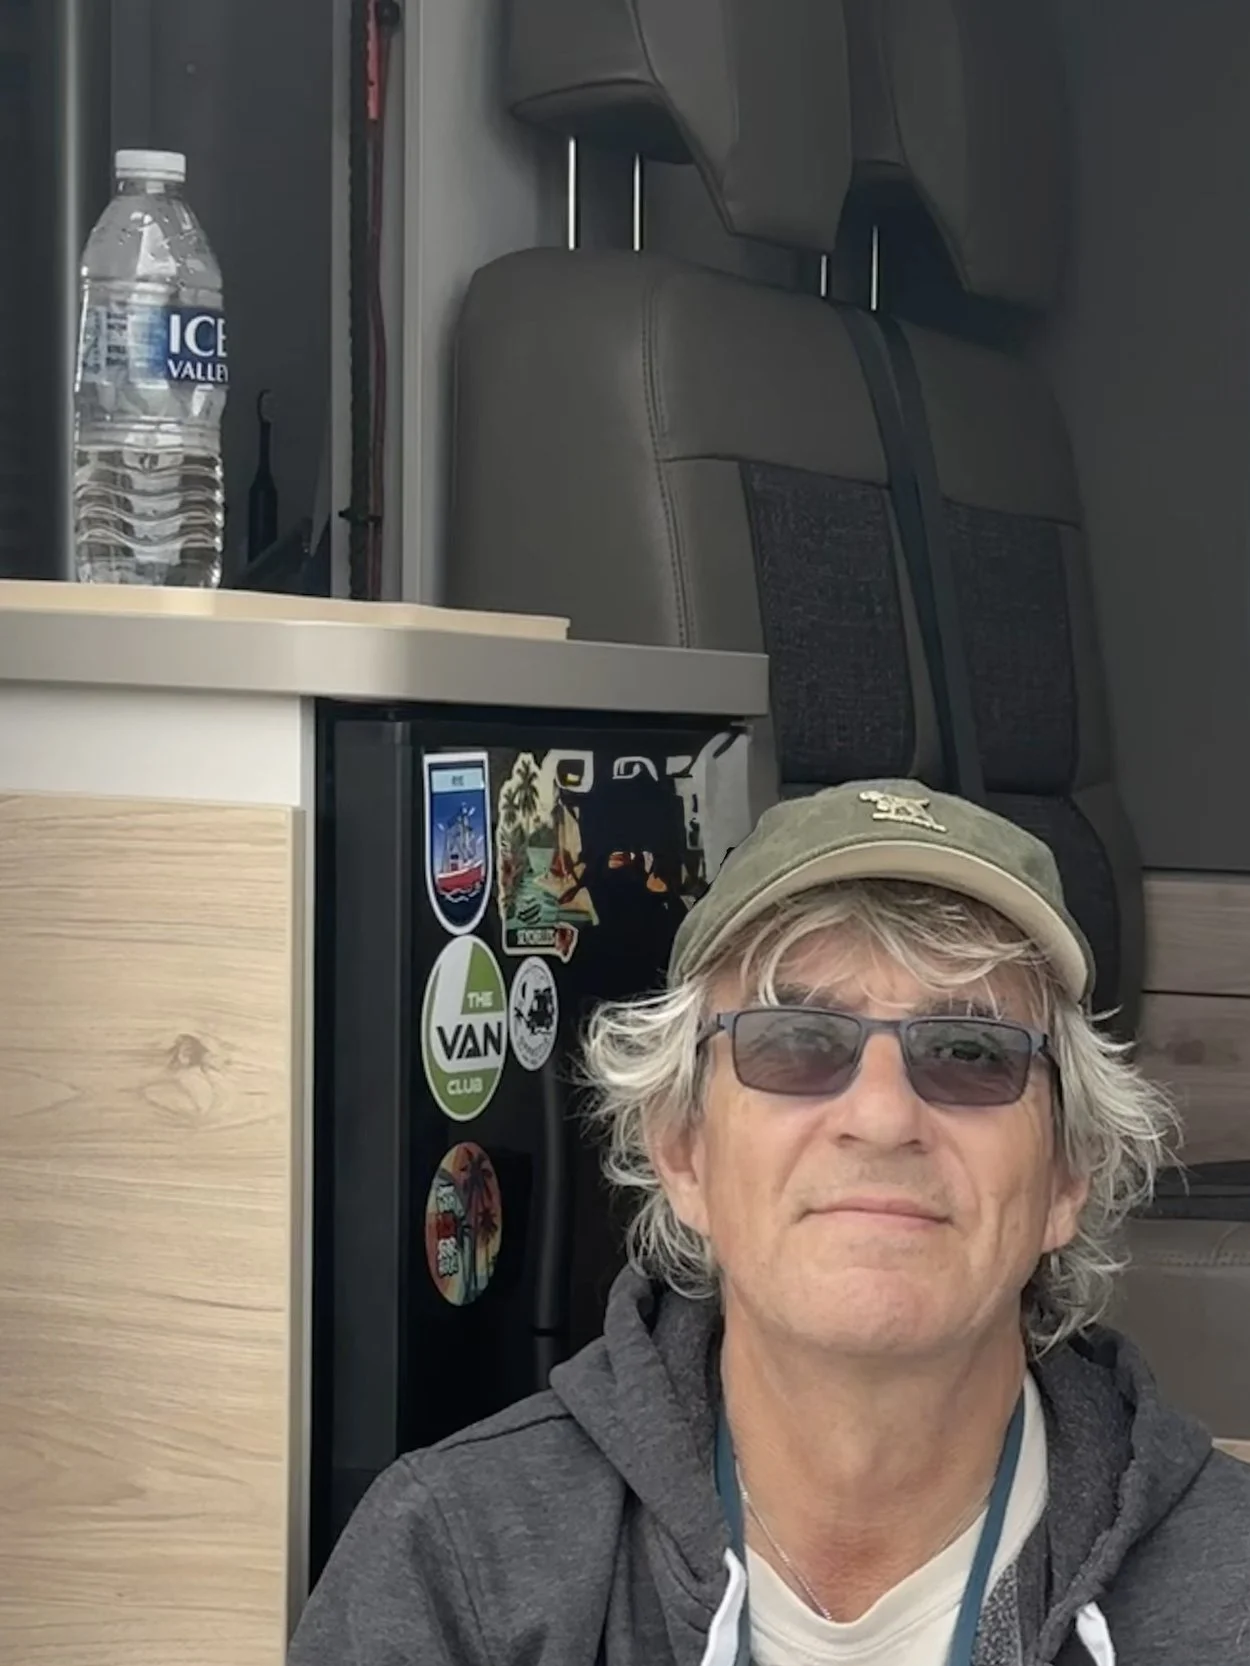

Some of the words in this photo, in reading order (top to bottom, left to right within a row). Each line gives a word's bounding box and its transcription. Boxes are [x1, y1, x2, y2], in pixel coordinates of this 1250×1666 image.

[169, 313, 228, 358] ICE
[467, 990, 494, 1009] THE
[436, 1021, 502, 1061] VAN
[446, 1077, 483, 1096] CLUB
